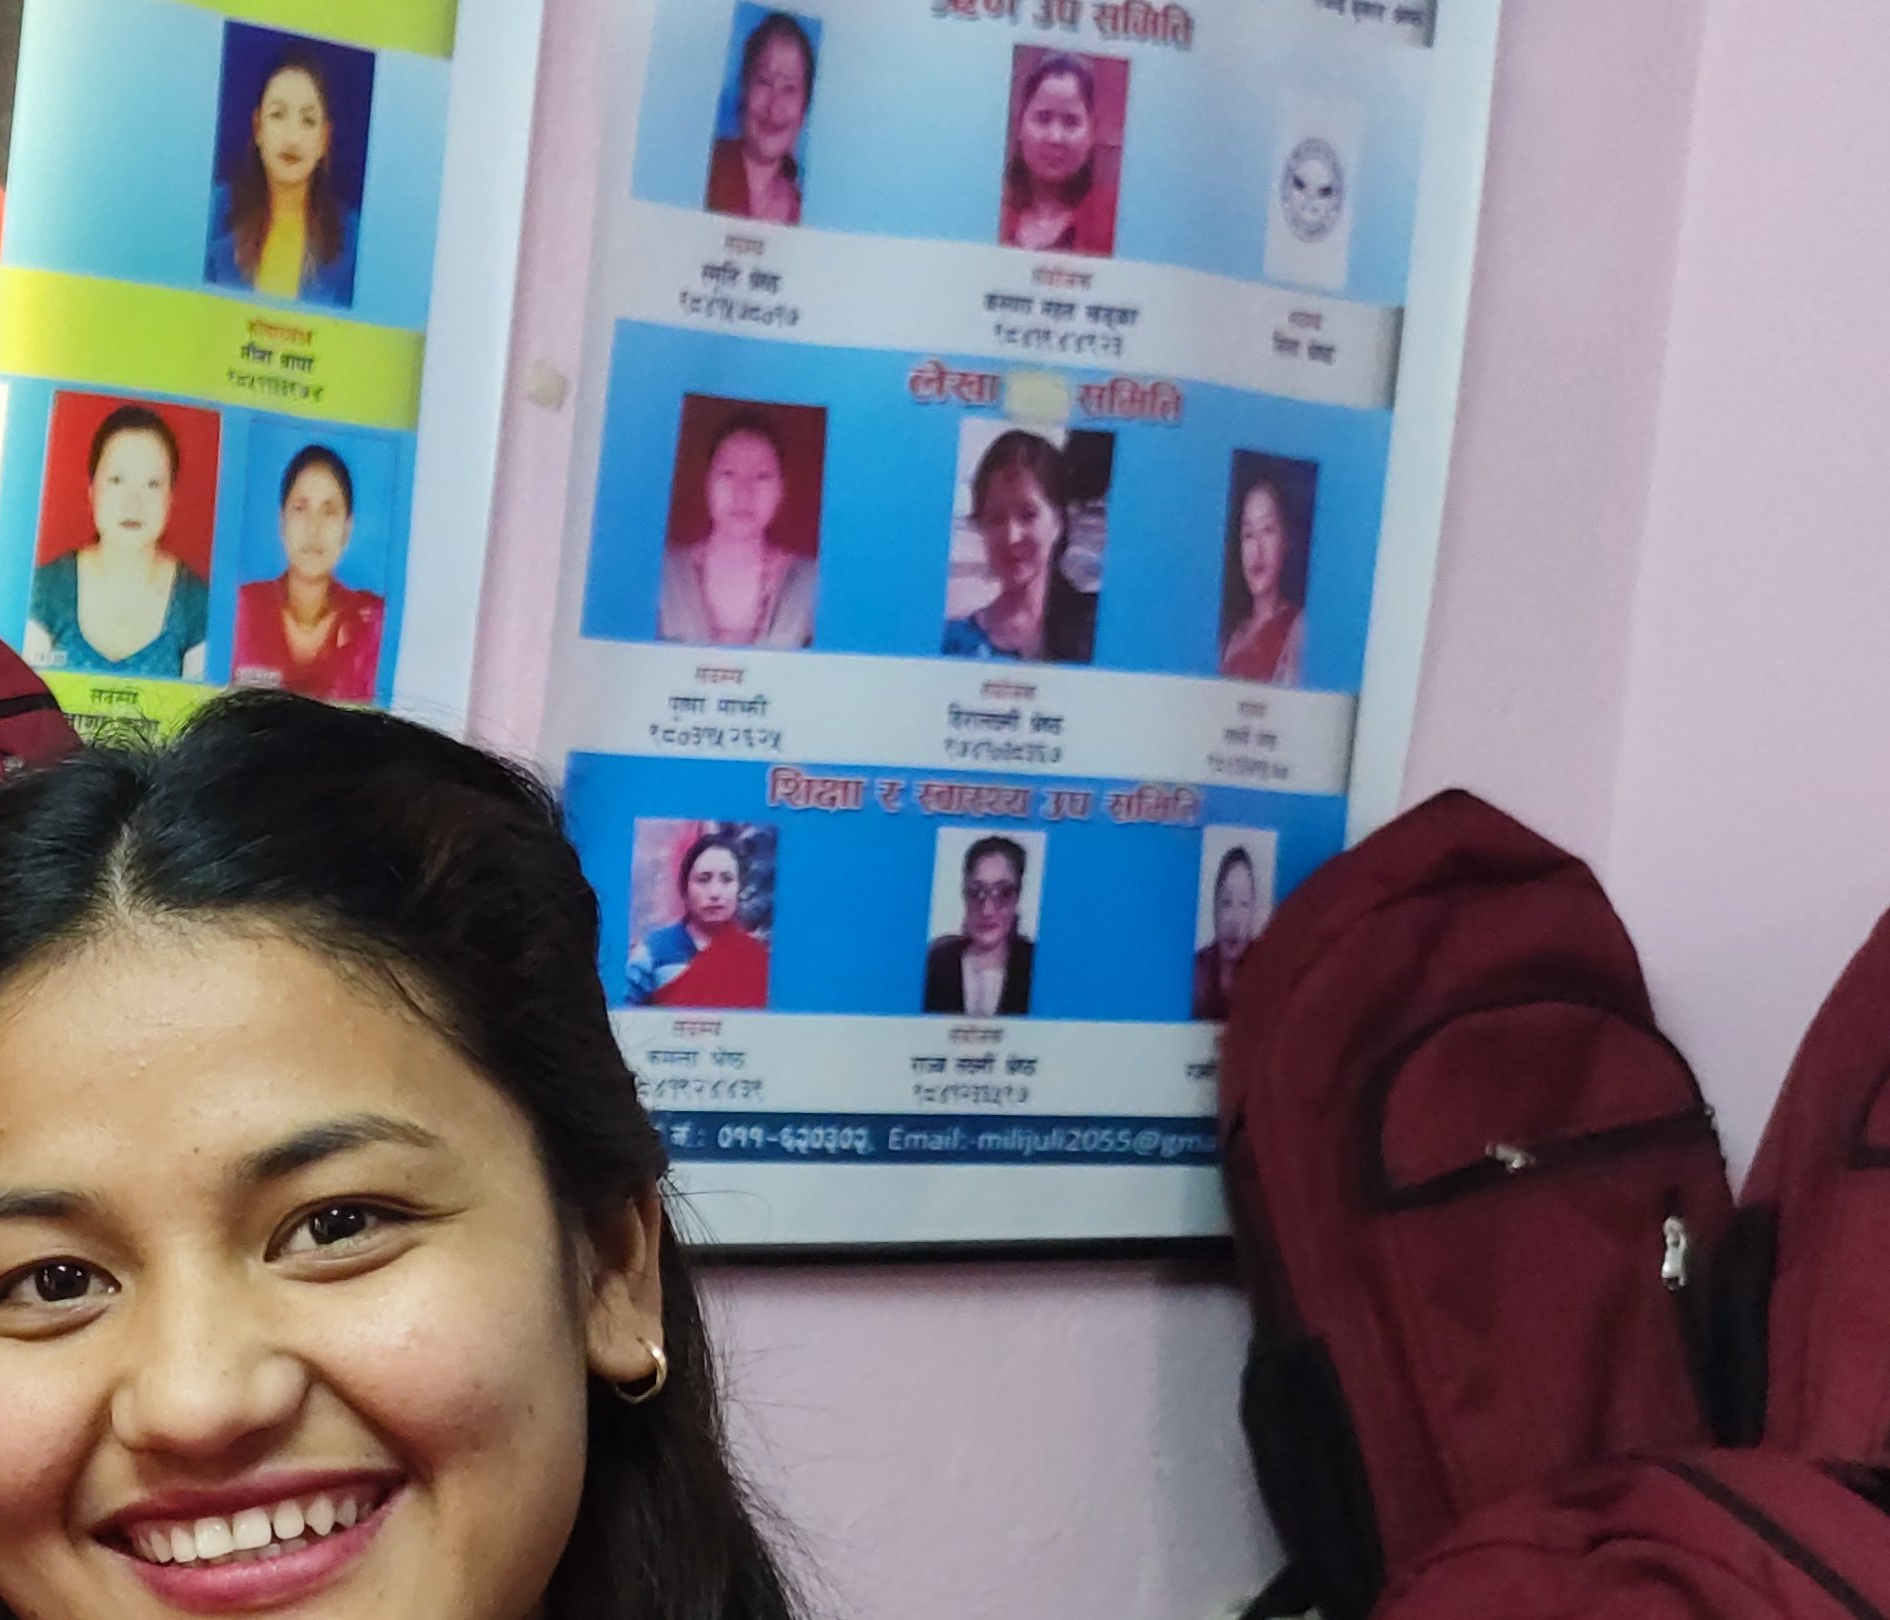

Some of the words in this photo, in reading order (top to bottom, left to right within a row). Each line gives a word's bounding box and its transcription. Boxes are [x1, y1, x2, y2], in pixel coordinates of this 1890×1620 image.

[1092, 0, 1194, 49] समिति
[908, 358, 1000, 406] लेखा
[1077, 377, 1183, 424] समिति
[767, 766, 864, 812] शिक्षा
[874, 780, 903, 813] र
[1043, 789, 1090, 820] उप
